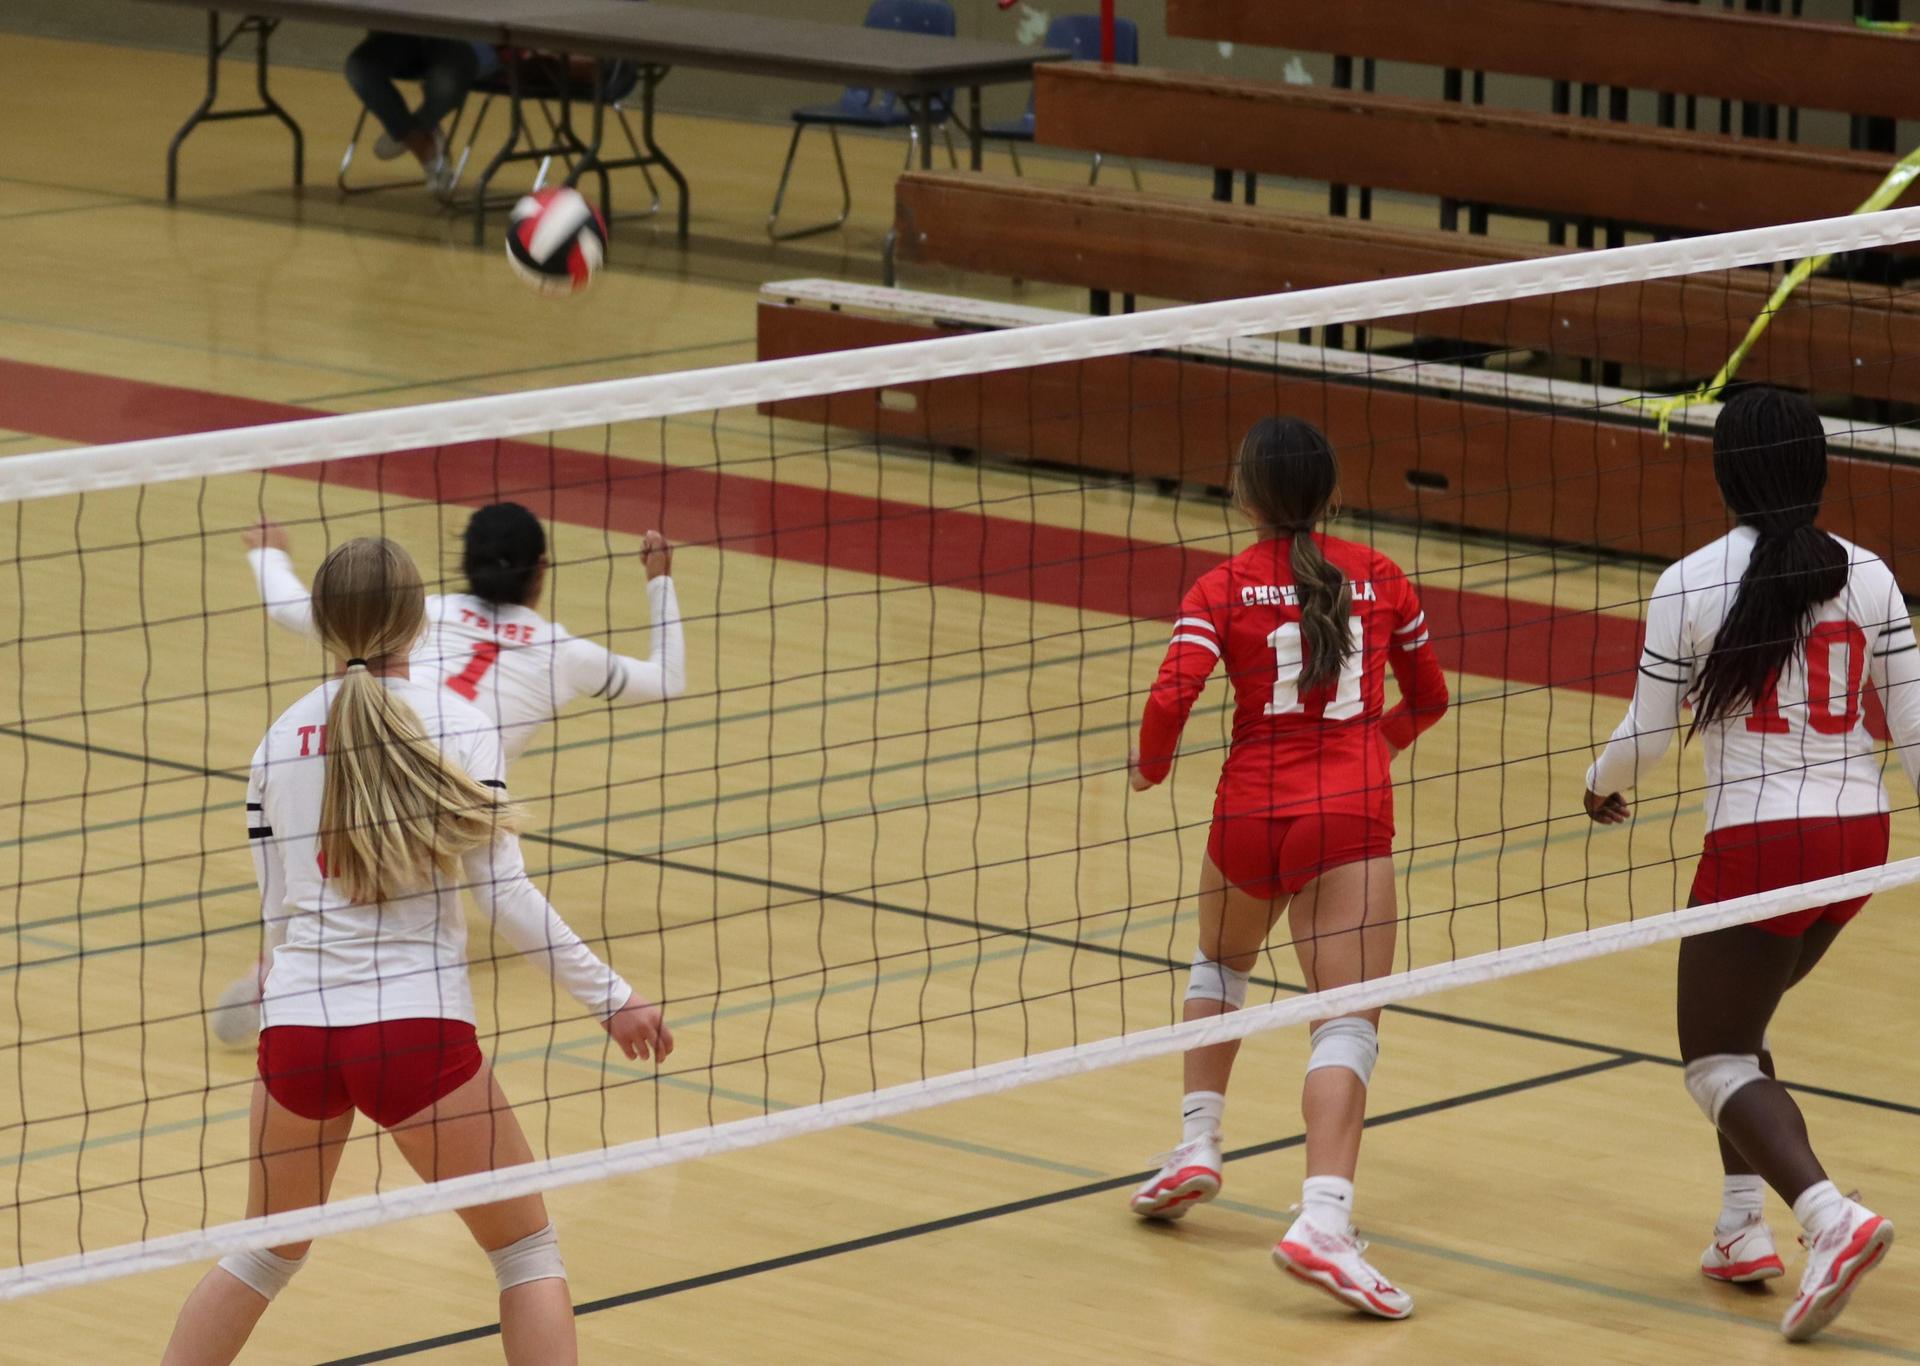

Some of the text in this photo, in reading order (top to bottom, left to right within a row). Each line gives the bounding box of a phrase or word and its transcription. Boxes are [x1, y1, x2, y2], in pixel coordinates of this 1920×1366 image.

[1241, 580, 1377, 606] CHOWLA
[445, 640, 500, 702] 1
[1263, 616, 1364, 720] 11
